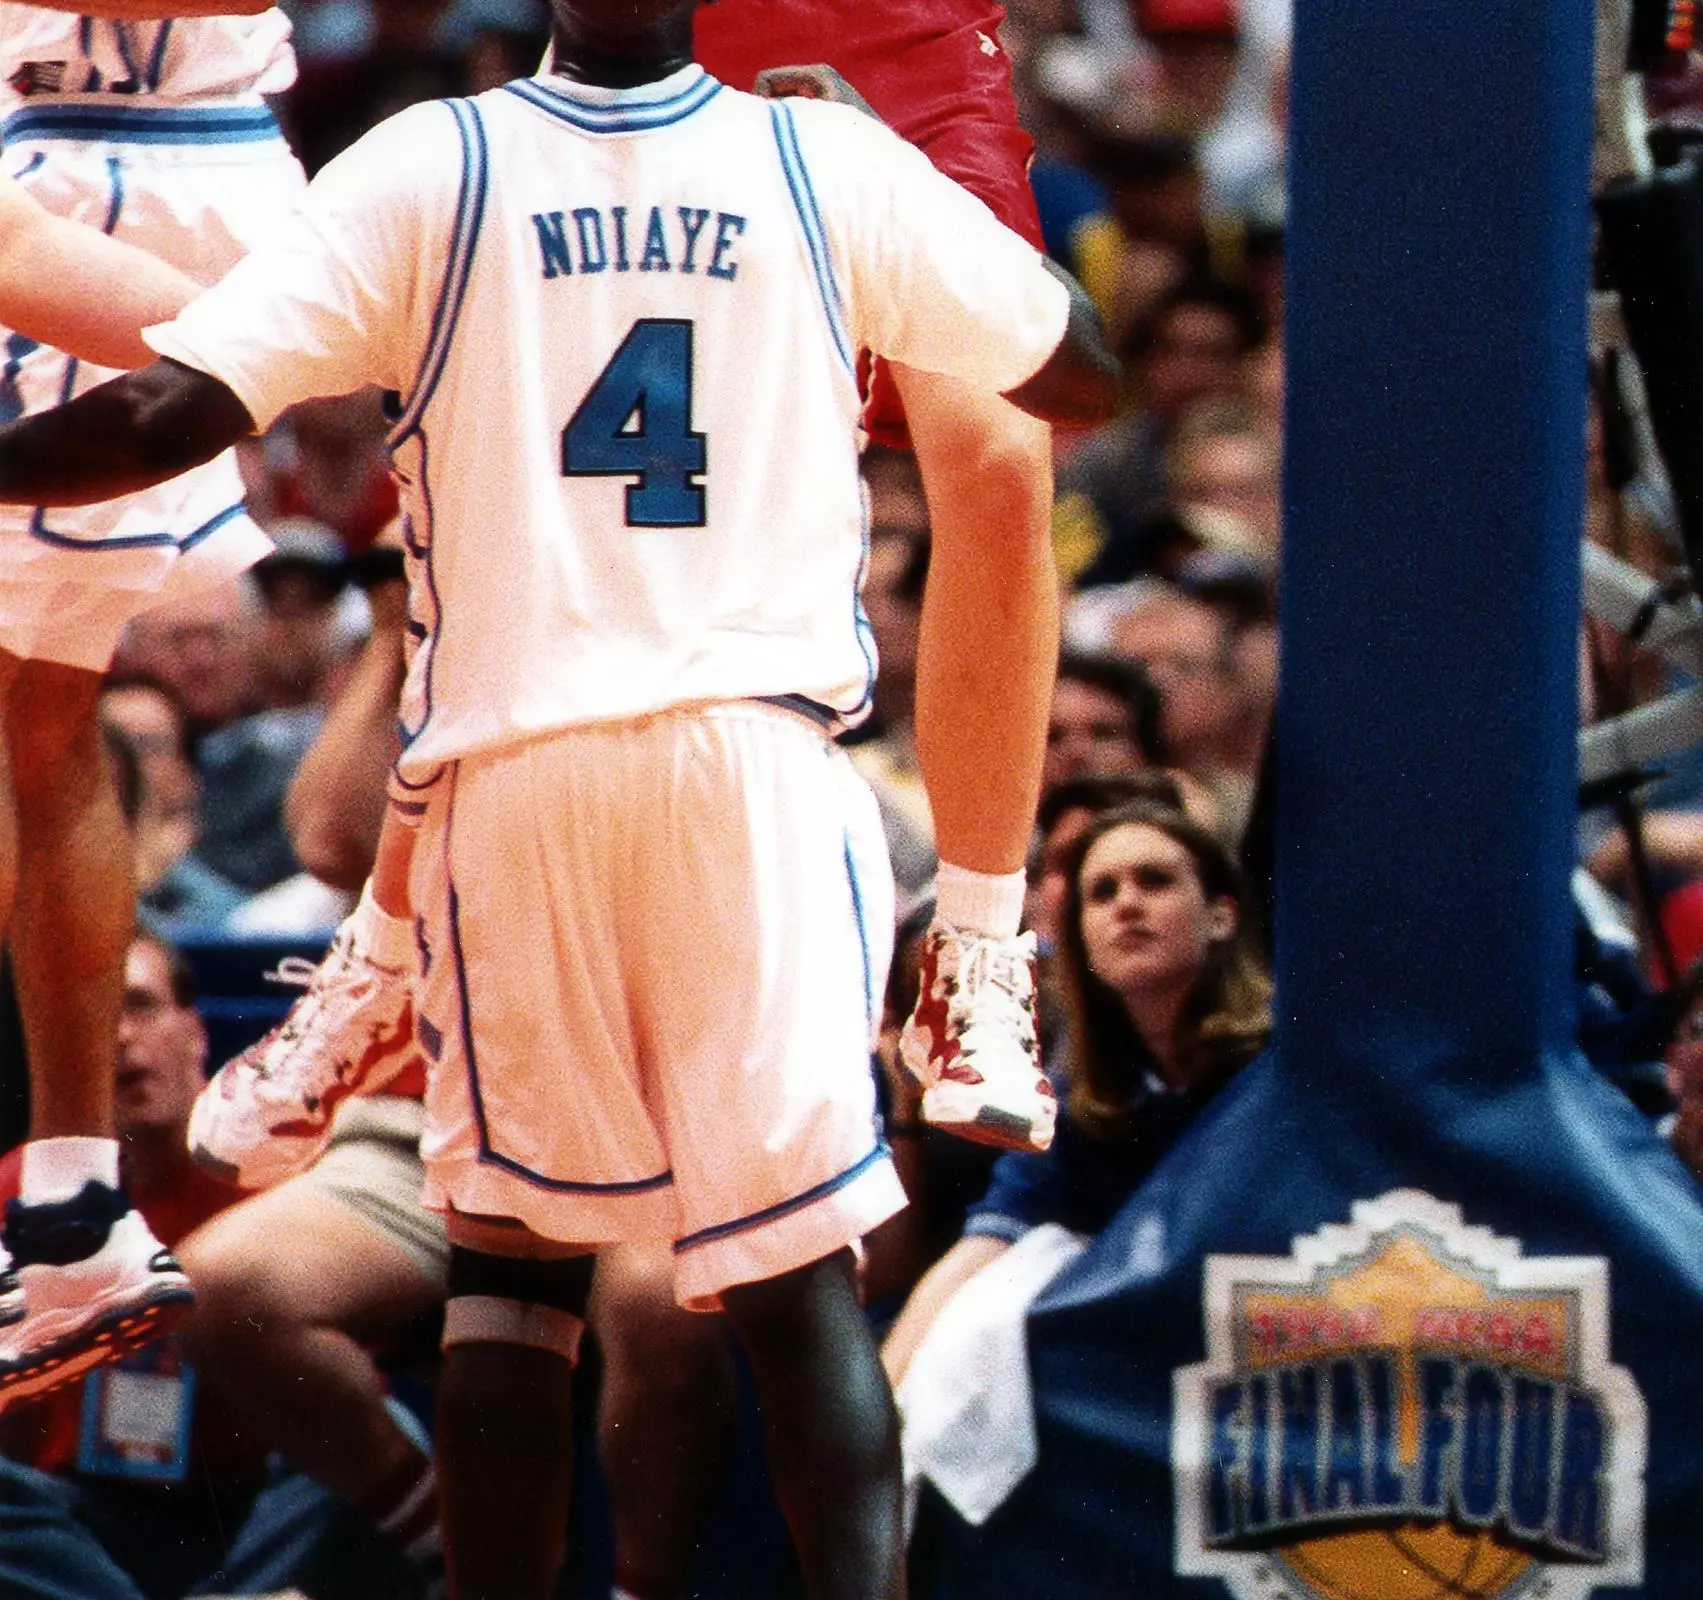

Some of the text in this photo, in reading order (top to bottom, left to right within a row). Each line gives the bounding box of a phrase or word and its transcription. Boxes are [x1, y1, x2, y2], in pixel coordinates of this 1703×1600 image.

[532, 205, 747, 281] NDIAYE
[562, 318, 706, 527] 4
[1206, 1350, 1606, 1560] FINAL FOUR
